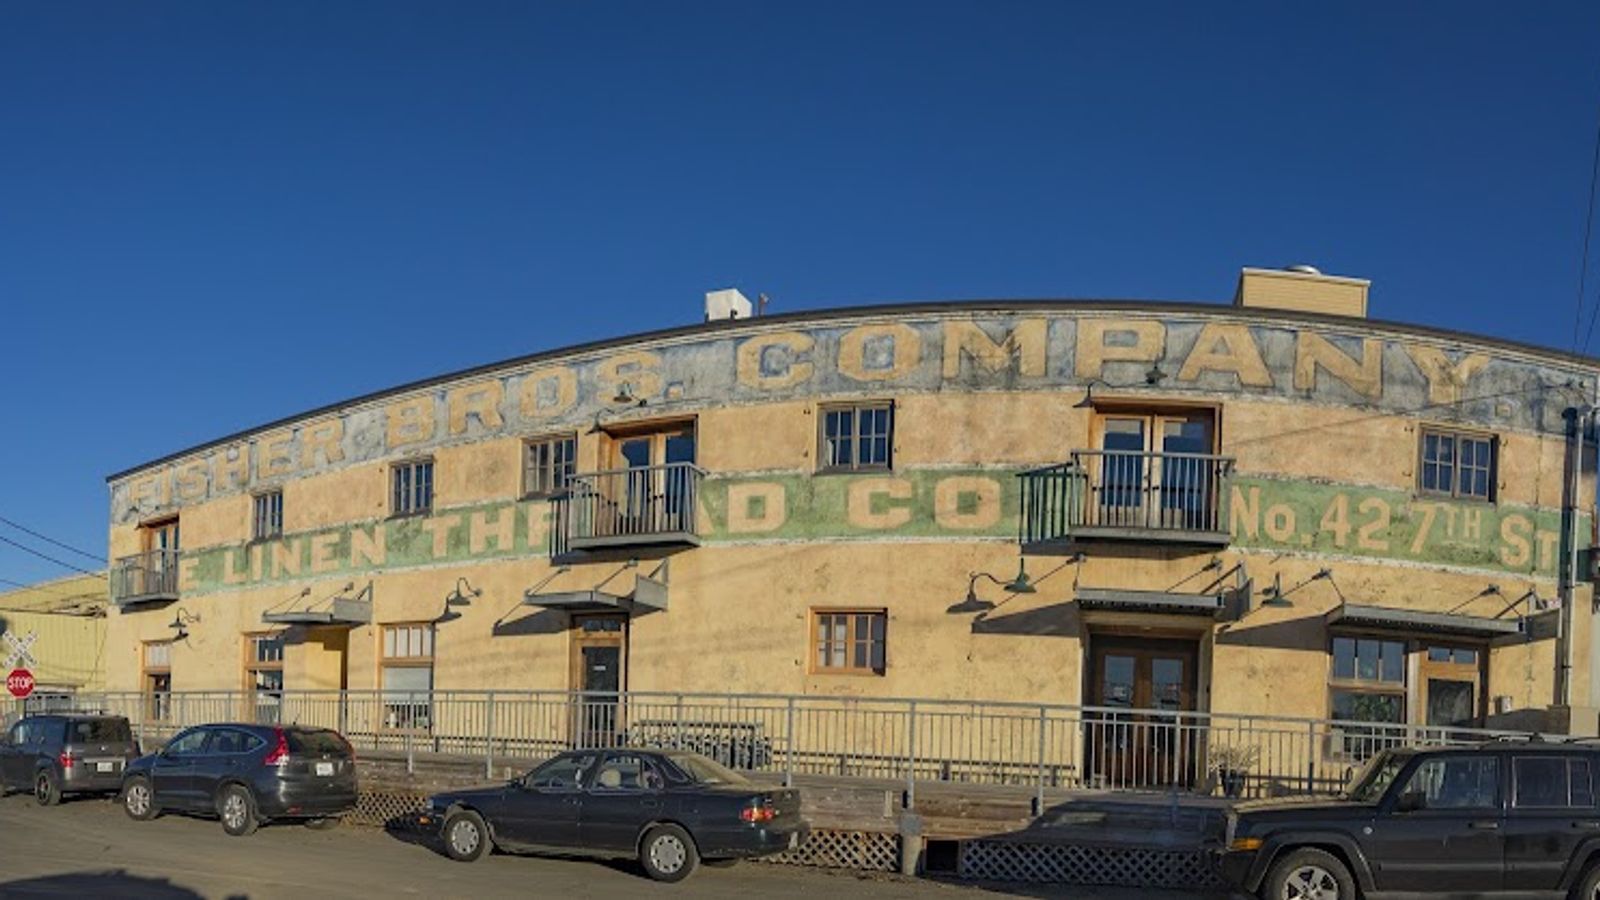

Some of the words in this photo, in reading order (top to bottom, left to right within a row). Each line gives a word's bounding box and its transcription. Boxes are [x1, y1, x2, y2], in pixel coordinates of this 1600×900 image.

[386, 351, 684, 447] BROS.
[736, 317, 1491, 405] COMPANY
[223, 524, 387, 584] LINEN
[848, 475, 1002, 530] CO
[1320, 496, 1390, 552] 42
[8, 676, 33, 689] STOP
